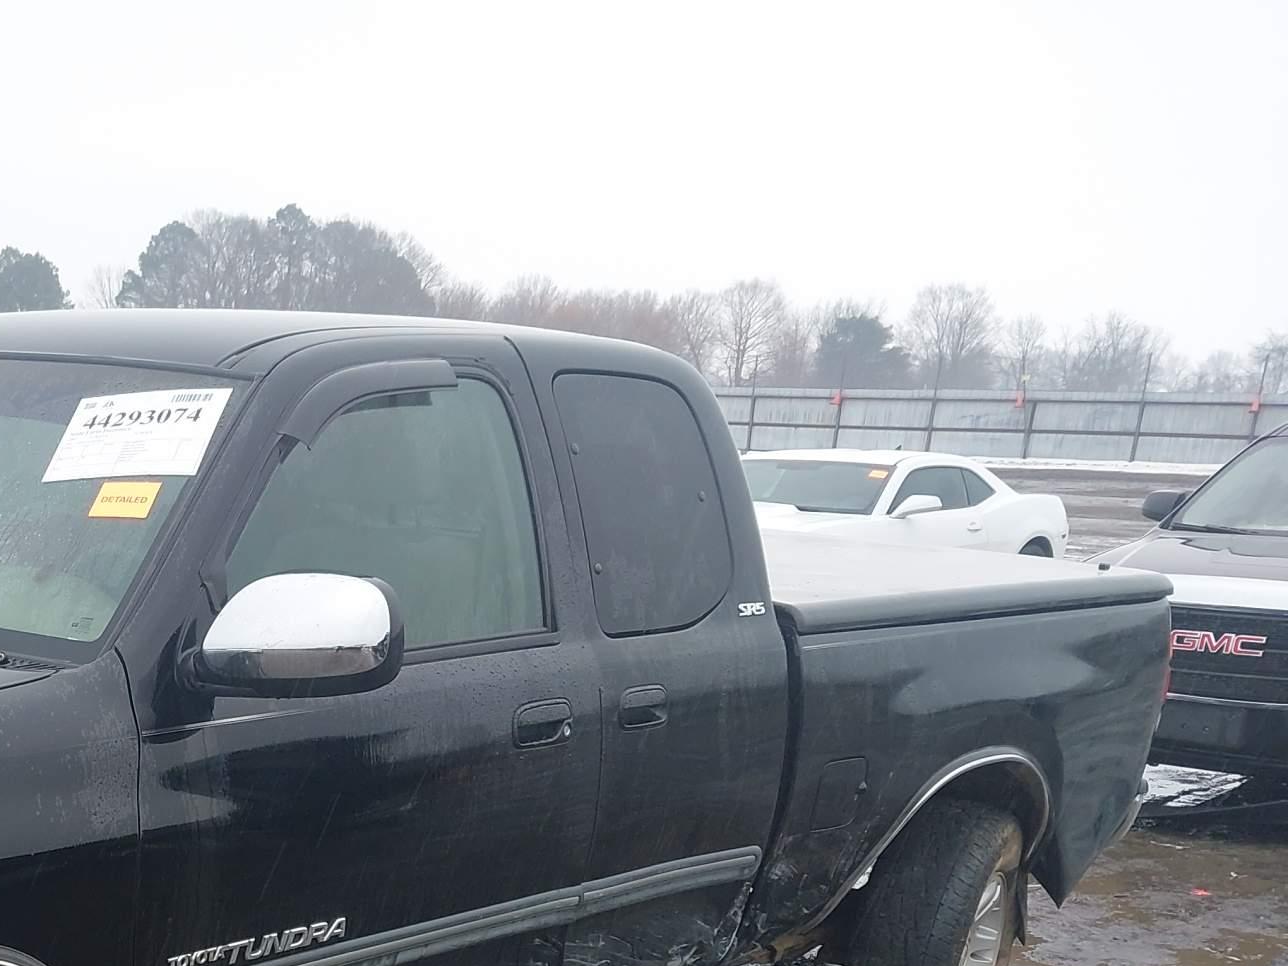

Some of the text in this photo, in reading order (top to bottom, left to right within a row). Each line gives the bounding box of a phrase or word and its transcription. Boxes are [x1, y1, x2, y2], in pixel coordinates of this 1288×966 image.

[83, 406, 203, 430] 44293074
[100, 495, 148, 504] DETAILED
[738, 602, 766, 617] SR5
[1170, 629, 1268, 657] GMC
[225, 917, 347, 965] TUNDRA
